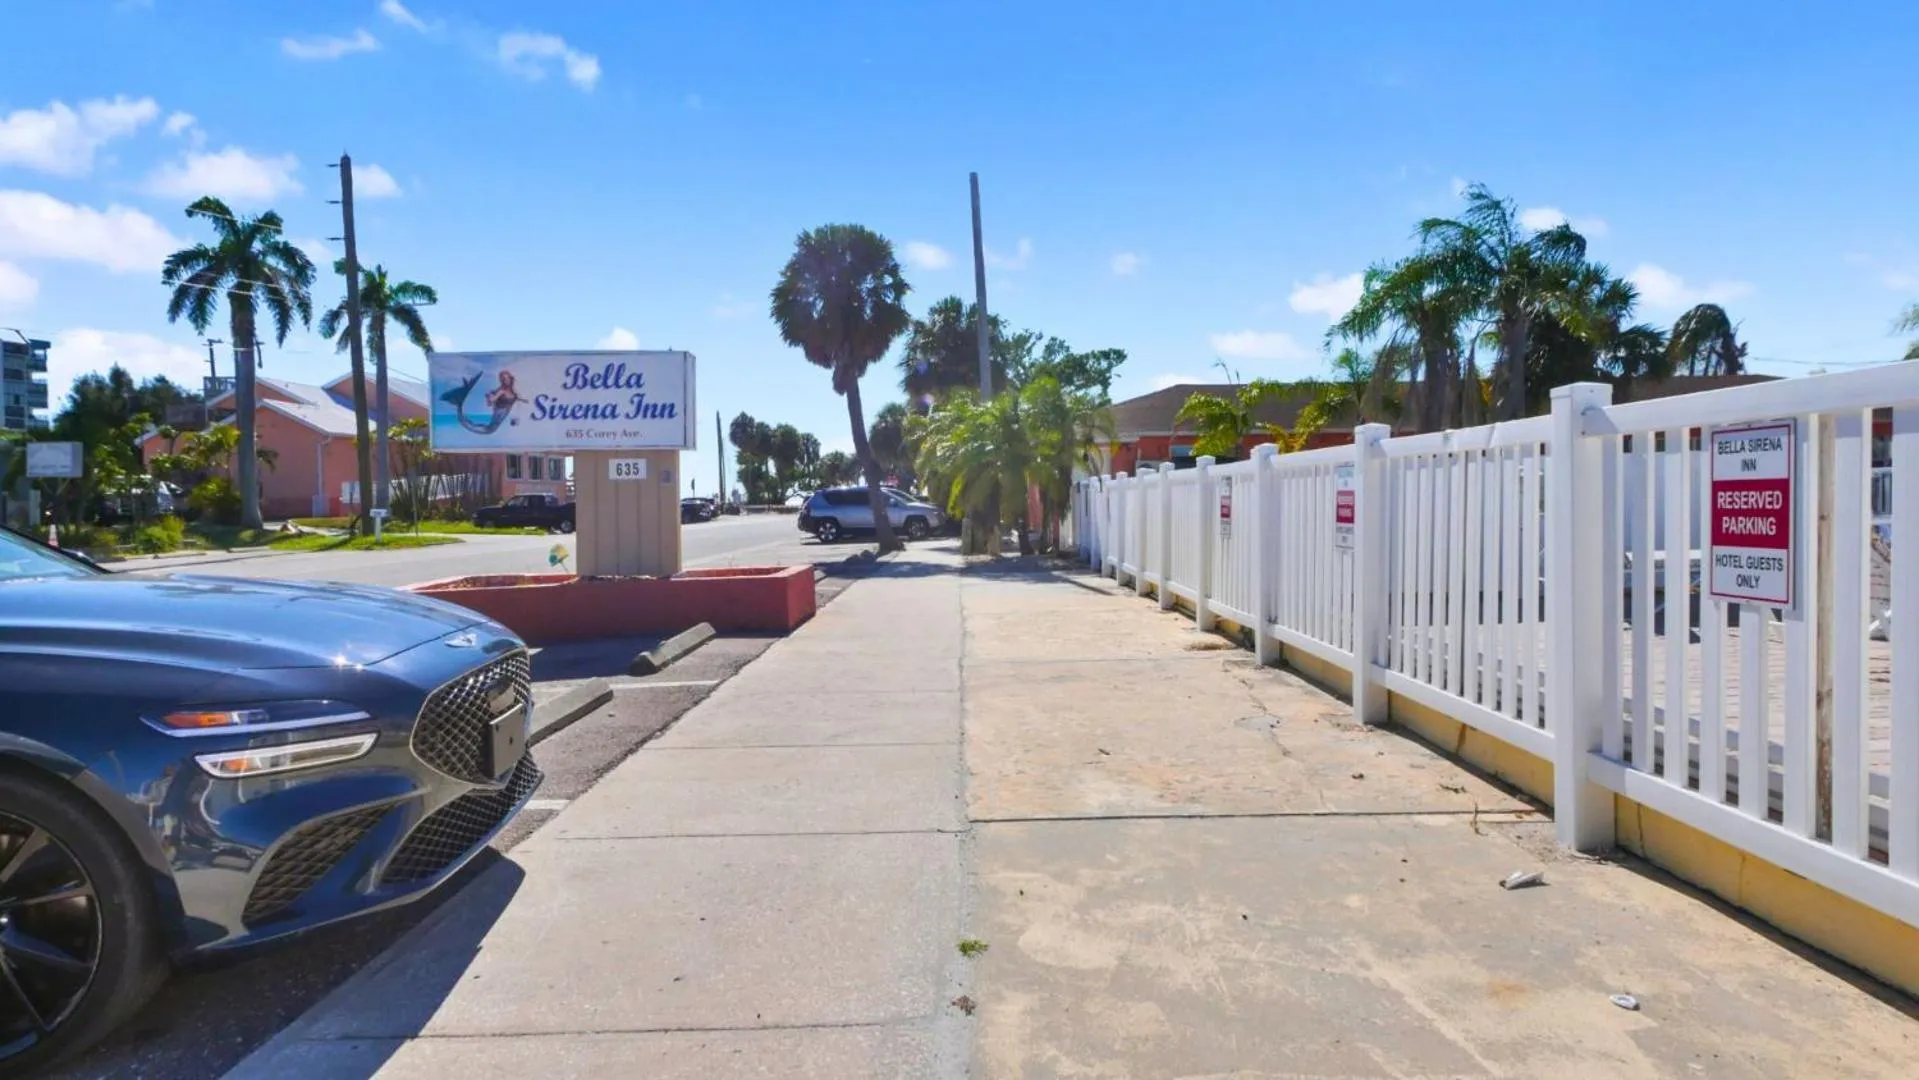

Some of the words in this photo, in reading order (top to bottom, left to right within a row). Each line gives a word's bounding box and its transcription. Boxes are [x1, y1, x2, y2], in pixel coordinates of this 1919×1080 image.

[562, 363, 645, 390] Bella
[530, 394, 620, 421] Sirena
[625, 393, 677, 420] Inn
[565, 429, 584, 439] 635
[1718, 438, 1746, 455] BELLA
[1748, 438, 1782, 452] SIRENA
[616, 463, 640, 476] 635
[1741, 459, 1757, 472] INN
[1717, 491, 1782, 509] RESERVED
[1722, 516, 1777, 535] PARKING
[1715, 554, 1744, 569] HOTEL
[1746, 557, 1784, 572] GUESTS
[1736, 574, 1761, 588] ONLY
